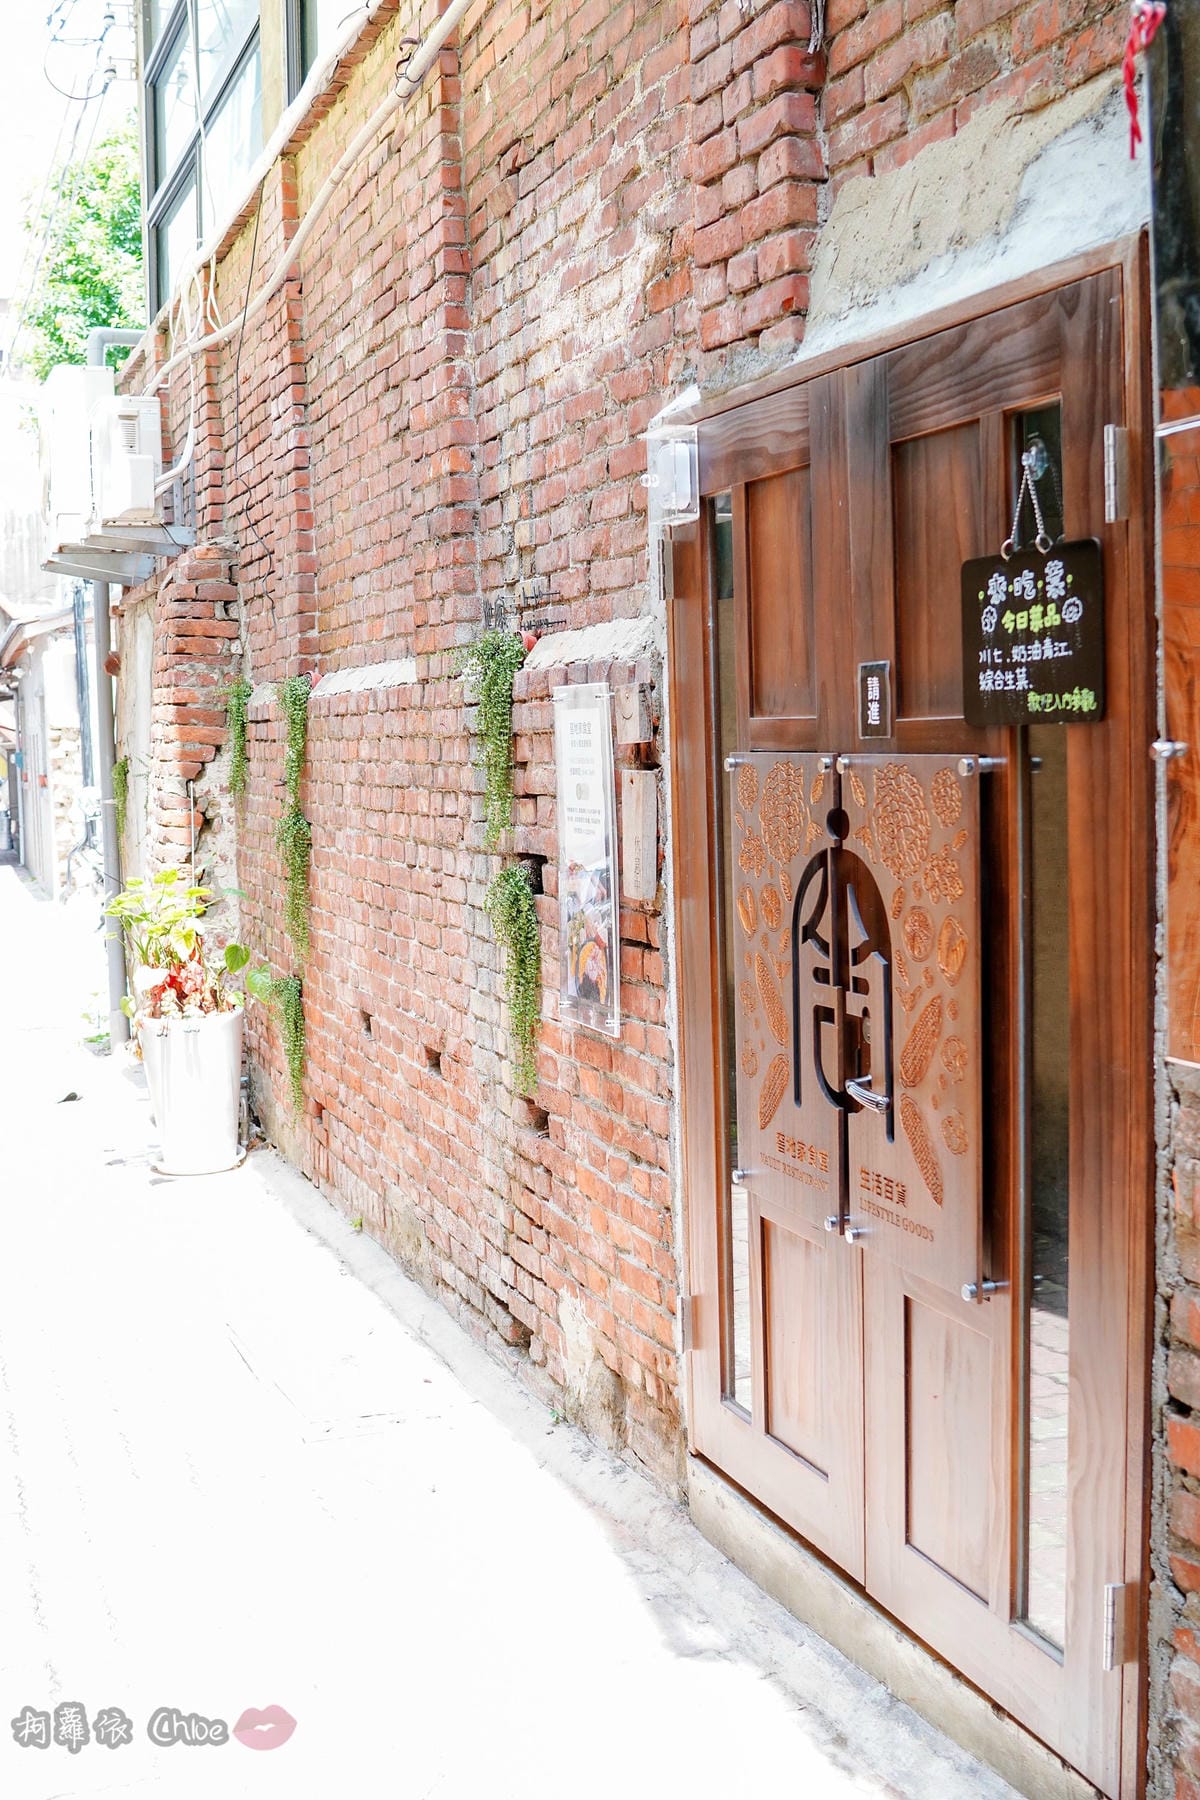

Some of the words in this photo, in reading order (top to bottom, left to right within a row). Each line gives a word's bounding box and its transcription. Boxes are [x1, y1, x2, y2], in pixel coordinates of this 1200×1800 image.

[1001, 602, 1061, 634] 今日菜品
[860, 1166, 907, 1208] 生活百貨
[859, 1198, 900, 1227] LIFESTYLE
[902, 1217, 934, 1242] GOODS
